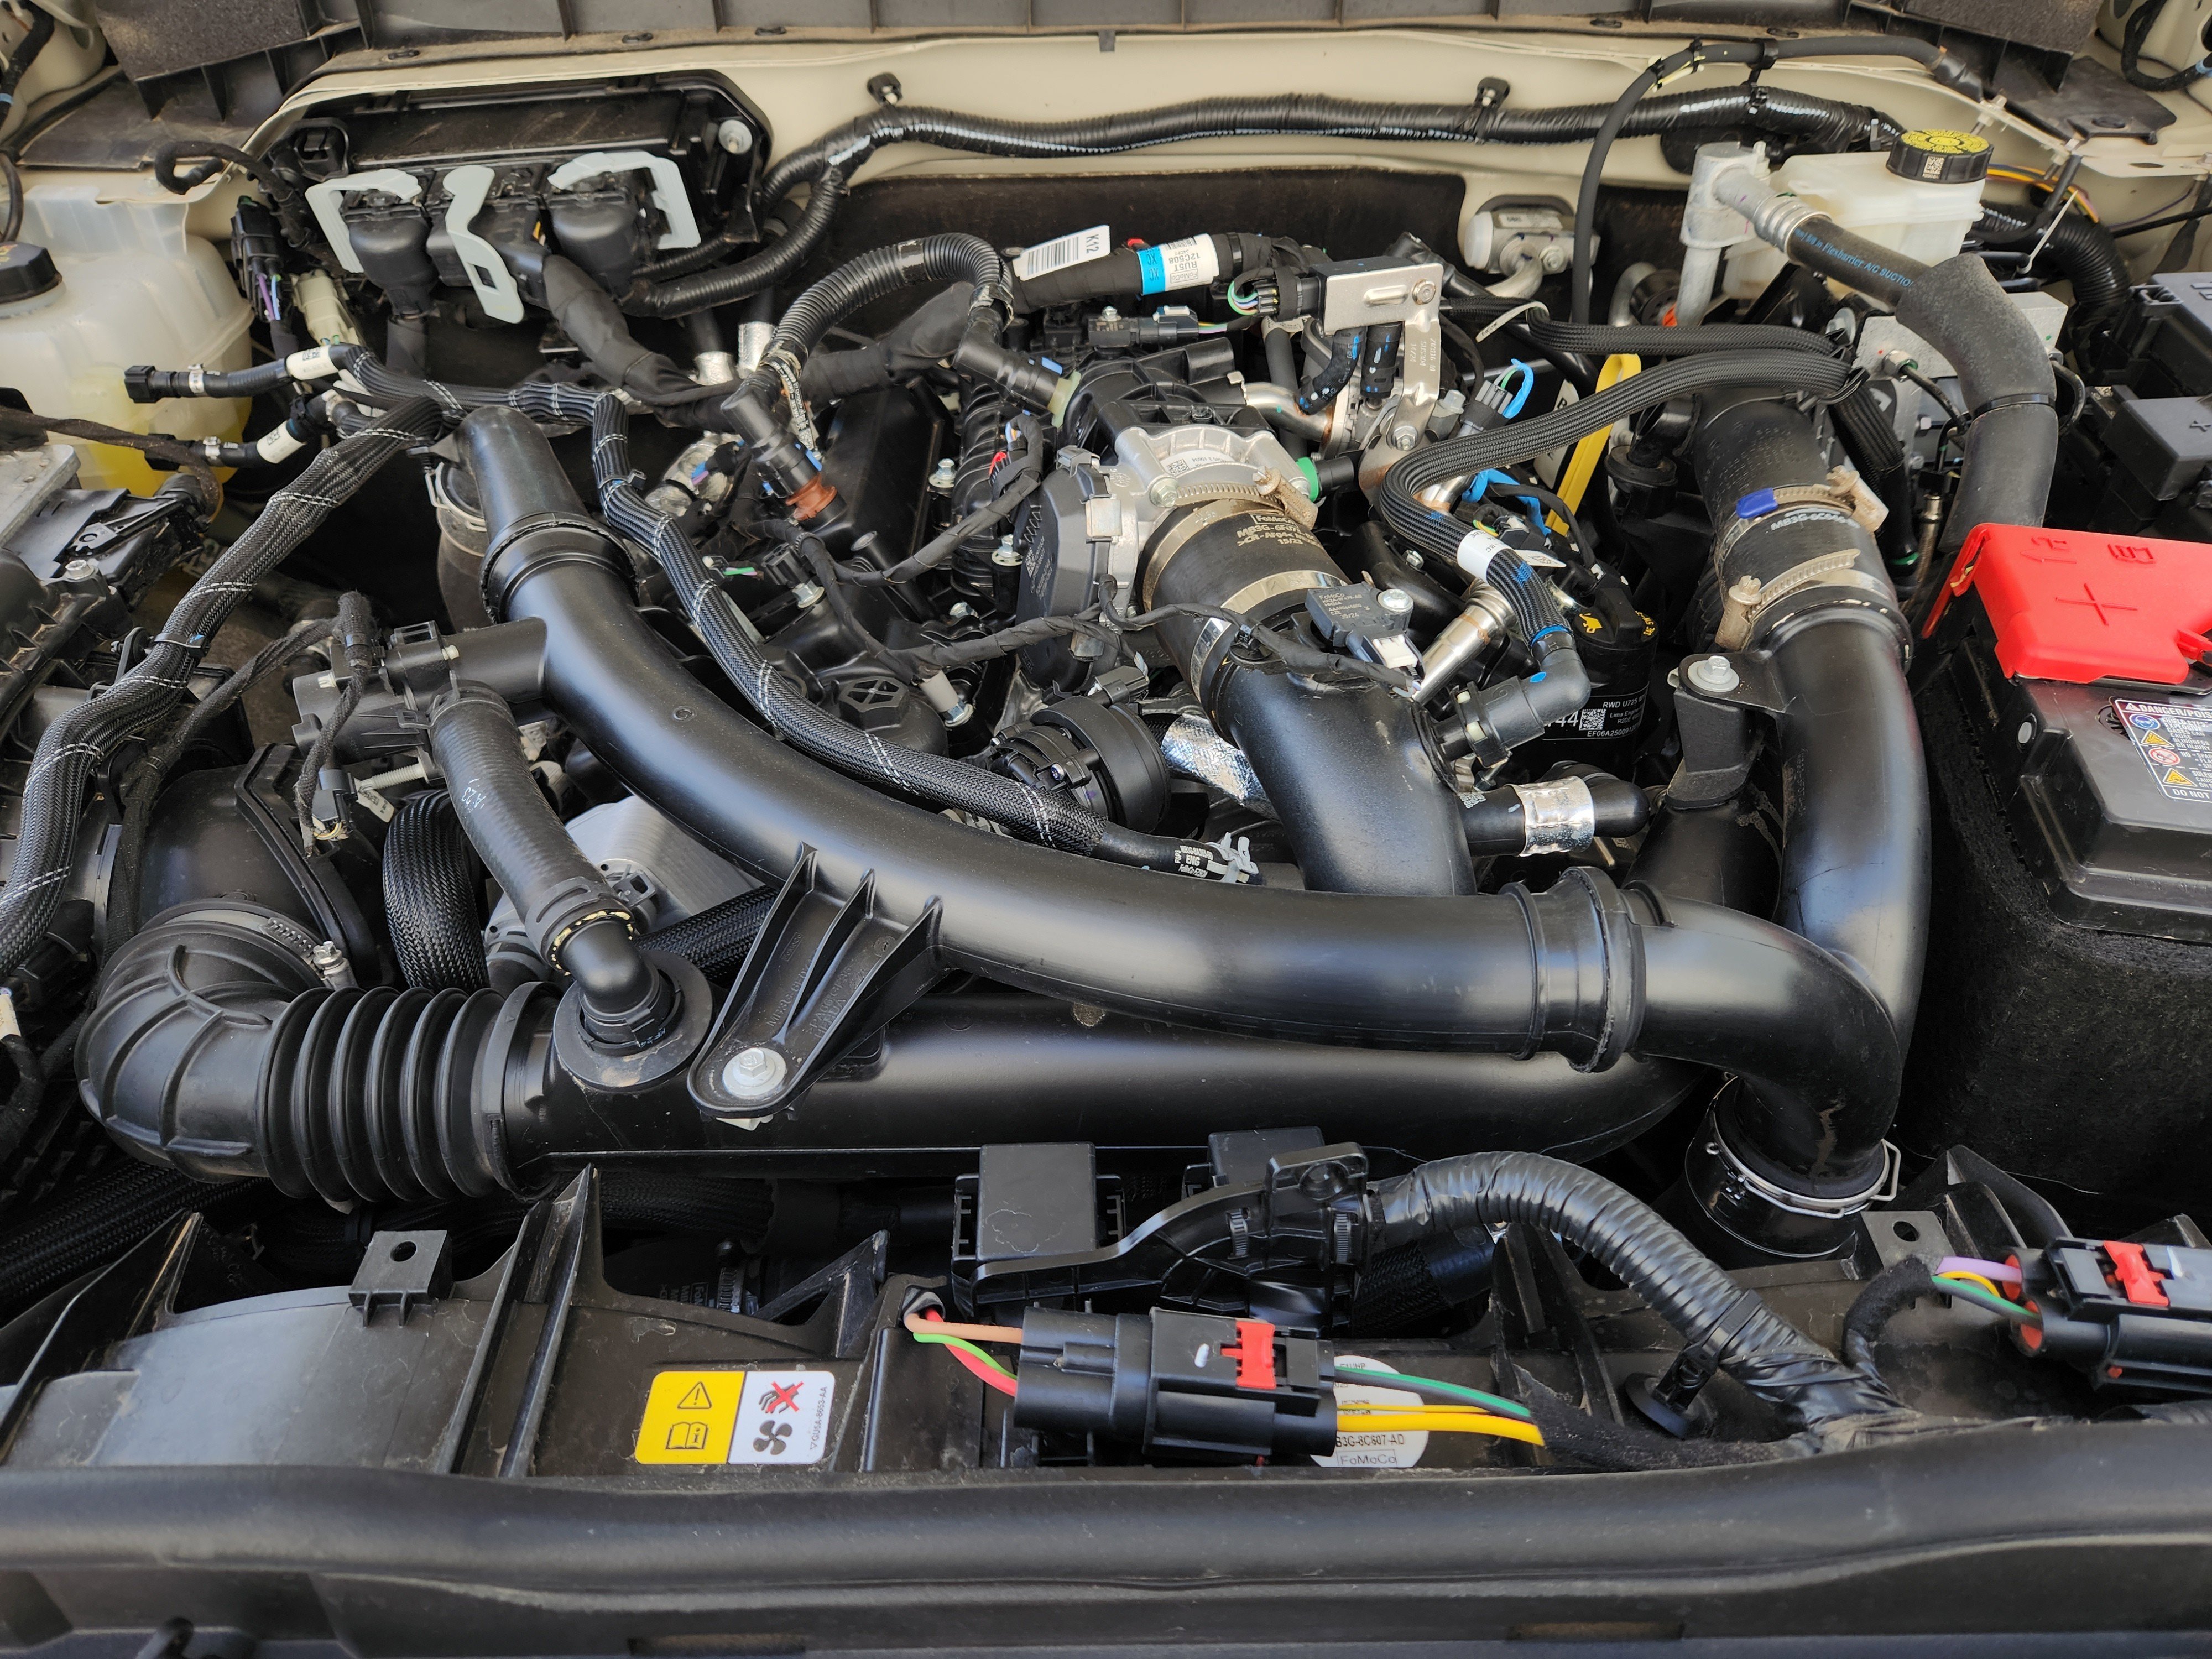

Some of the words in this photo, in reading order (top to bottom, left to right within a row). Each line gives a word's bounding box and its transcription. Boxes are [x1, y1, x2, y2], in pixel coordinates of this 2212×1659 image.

[1086, 234, 1099, 254] K12
[1146, 253, 1157, 265] XC
[1168, 253, 1201, 264] 12C508
[1174, 260, 1197, 271] RU5T
[1150, 268, 1160, 281] XC
[1171, 270, 1198, 283] FoMoCo
[1644, 625, 1655, 637] SAE
[1603, 701, 1620, 709] RWD
[1623, 698, 1637, 707] U725
[1548, 710, 1579, 728] 44
[2162, 717, 2187, 726] SHIELD
[2164, 723, 2204, 732] EXPLOSIVE
[2173, 737, 2210, 746] BLINDNESS
[2189, 791, 2210, 799] NOT
[1186, 854, 1201, 867] ENG
[812, 1386, 827, 1441] GU5A-8653-AA
[1340, 1454, 1397, 1465] FoMoCo
